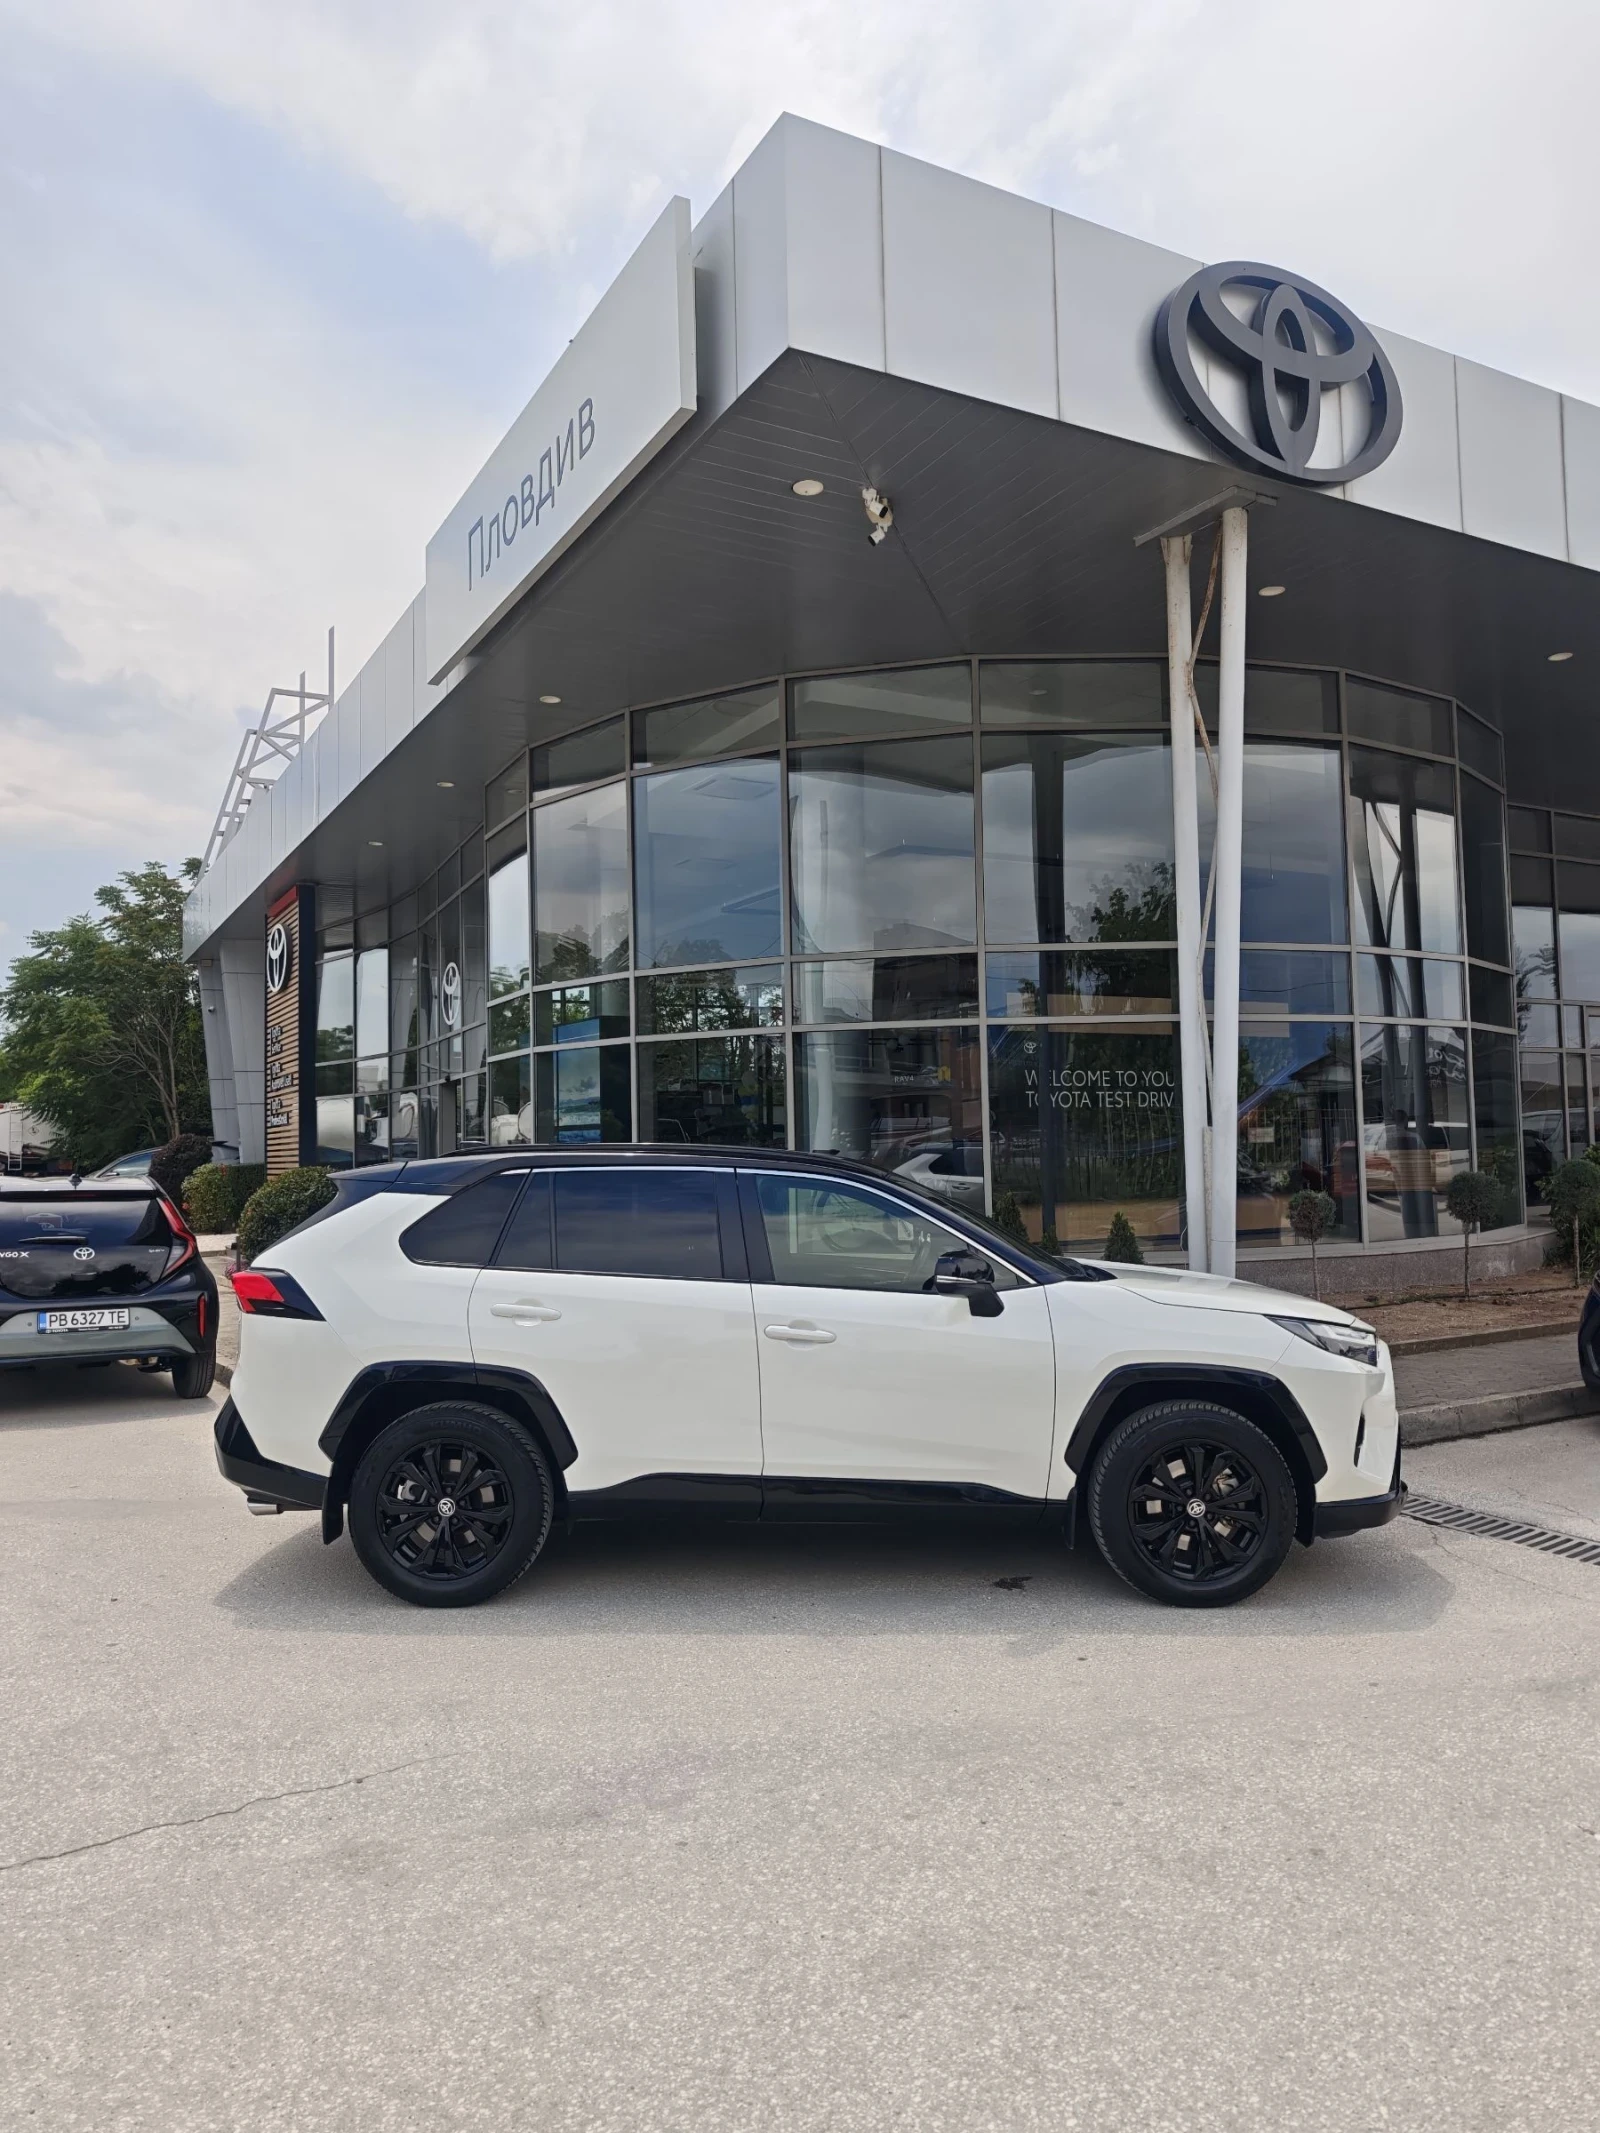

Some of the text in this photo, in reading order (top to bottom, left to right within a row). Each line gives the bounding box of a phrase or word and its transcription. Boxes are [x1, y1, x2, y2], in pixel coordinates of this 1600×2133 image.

[468, 397, 595, 592] Пловдив
[1025, 1069, 1111, 1087] WLCOME
[1115, 1070, 1138, 1087] TO
[1095, 1091, 1132, 1108] TEST
[49, 1313, 68, 1327] PB
[71, 1311, 105, 1326] 6327
[108, 1310, 126, 1324] TE
